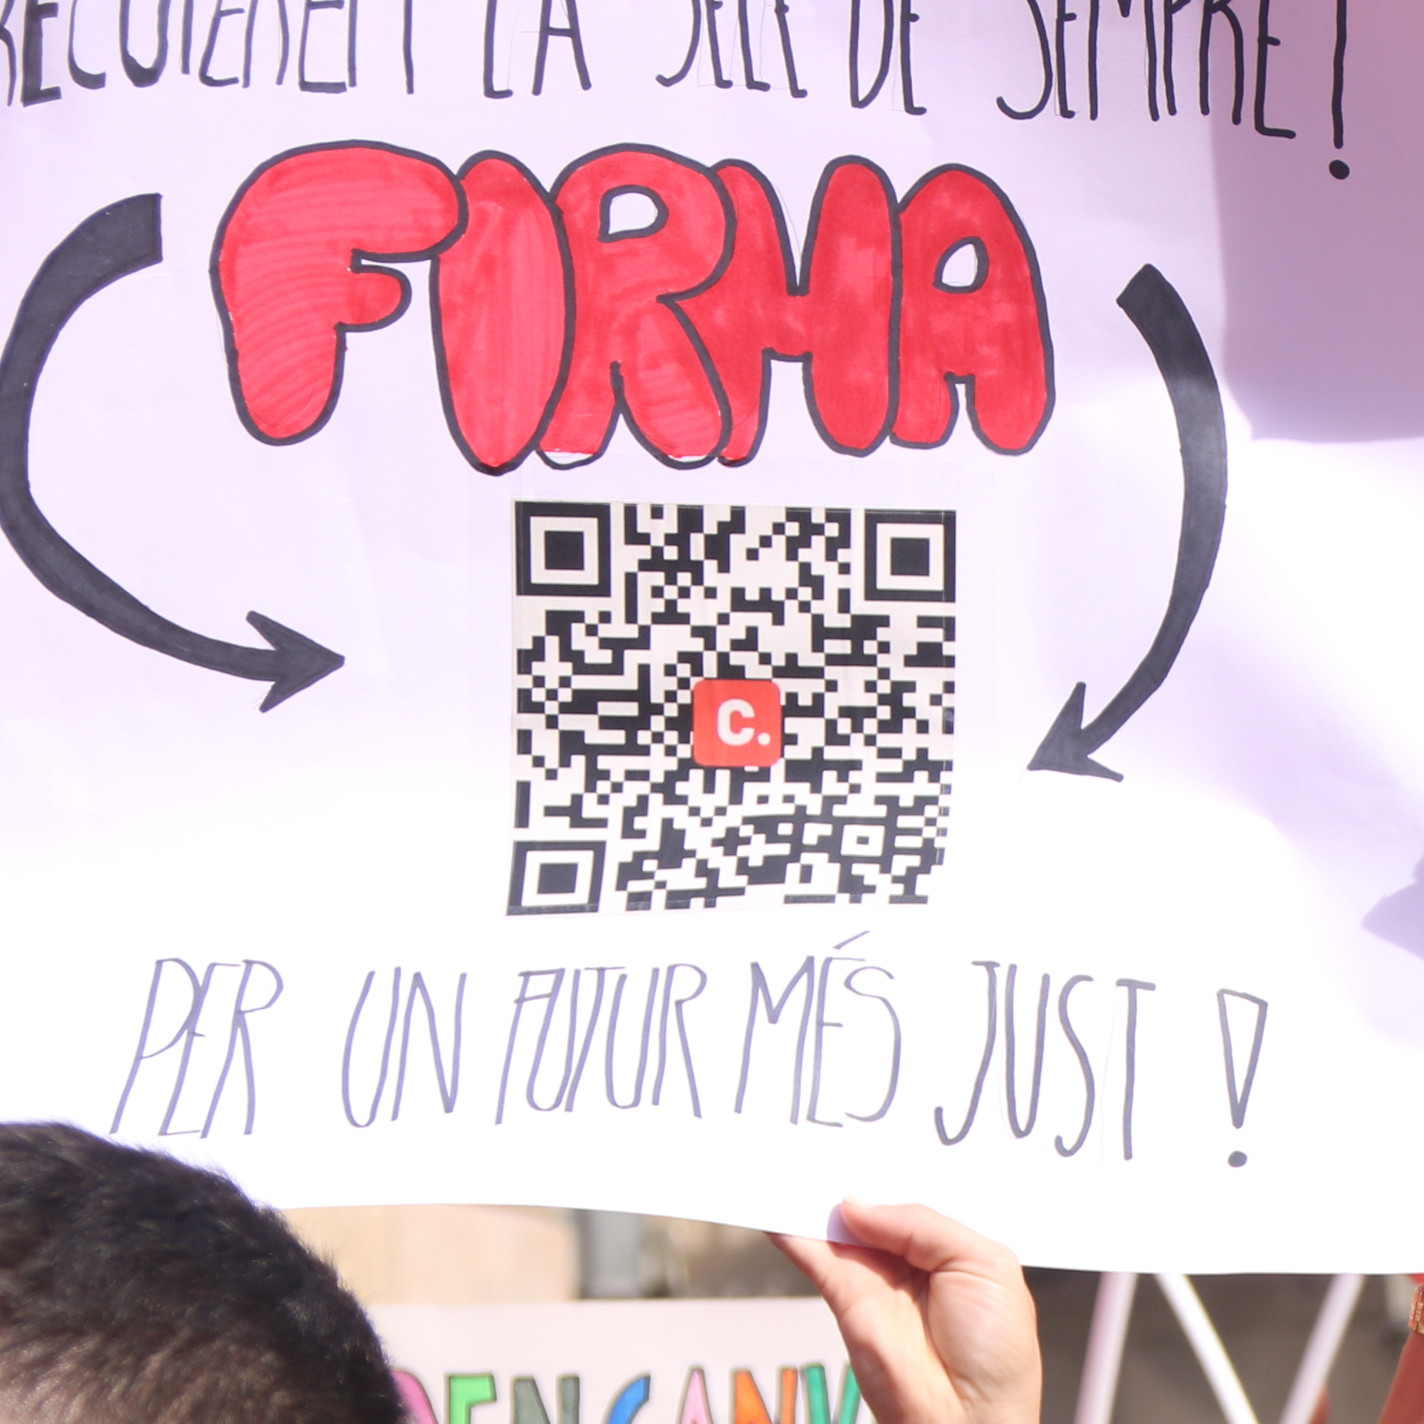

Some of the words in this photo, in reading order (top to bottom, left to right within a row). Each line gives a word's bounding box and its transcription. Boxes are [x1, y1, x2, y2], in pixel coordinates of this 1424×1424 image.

[108, 957, 284, 1139] PER
[341, 965, 467, 1128] UN
[494, 963, 708, 1125] FUTUR
[734, 930, 902, 1128] MÉS
[934, 960, 1157, 1161] JUST
